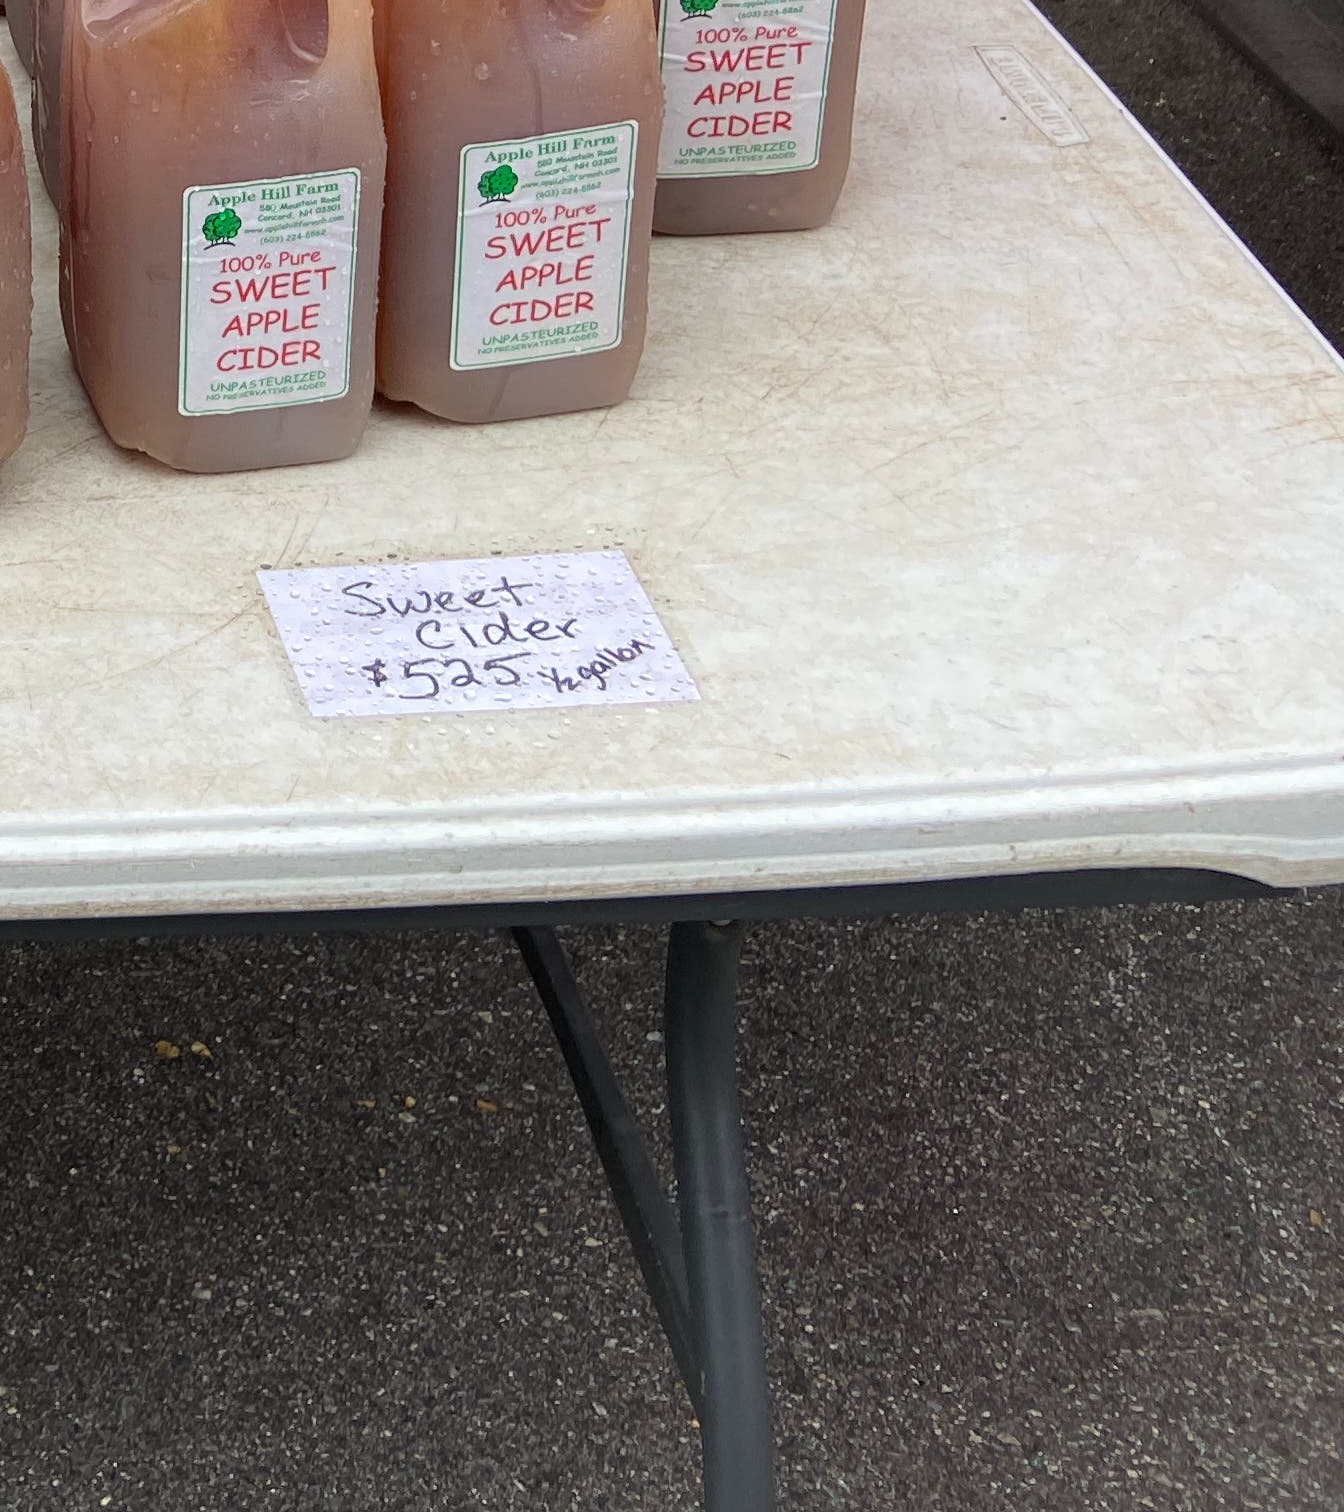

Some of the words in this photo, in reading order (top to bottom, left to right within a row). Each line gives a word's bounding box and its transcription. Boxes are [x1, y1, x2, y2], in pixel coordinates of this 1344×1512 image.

[695, 26, 748, 45] 100%
[754, 26, 798, 41] Pure
[684, 41, 812, 73] SWEET
[693, 76, 794, 106] APPLE
[687, 111, 792, 138] CIDER
[484, 148, 533, 163] Apple
[537, 140, 567, 156] Hill
[573, 136, 615, 149] Farm
[679, 140, 797, 157] UNPASTEURIZED
[208, 191, 256, 207] Apple
[261, 186, 291, 200] Hill
[296, 182, 339, 196] Farm
[495, 207, 547, 229] 100%
[554, 204, 596, 221] Pure
[484, 217, 611, 259] SWEET
[219, 253, 271, 273] 100%
[279, 251, 321, 267] Pure
[495, 254, 595, 293] APPLE
[210, 266, 336, 304] SWEET
[221, 303, 321, 339] APPLE
[489, 291, 594, 325] CIDER
[482, 321, 599, 346] UNPASTEURIZED
[216, 340, 321, 372] CIDER
[210, 370, 327, 392] UNPASTEURIZED
[341, 575, 533, 617] Sweet
[415, 611, 579, 649] Cider
[577, 637, 655, 691] gallon
